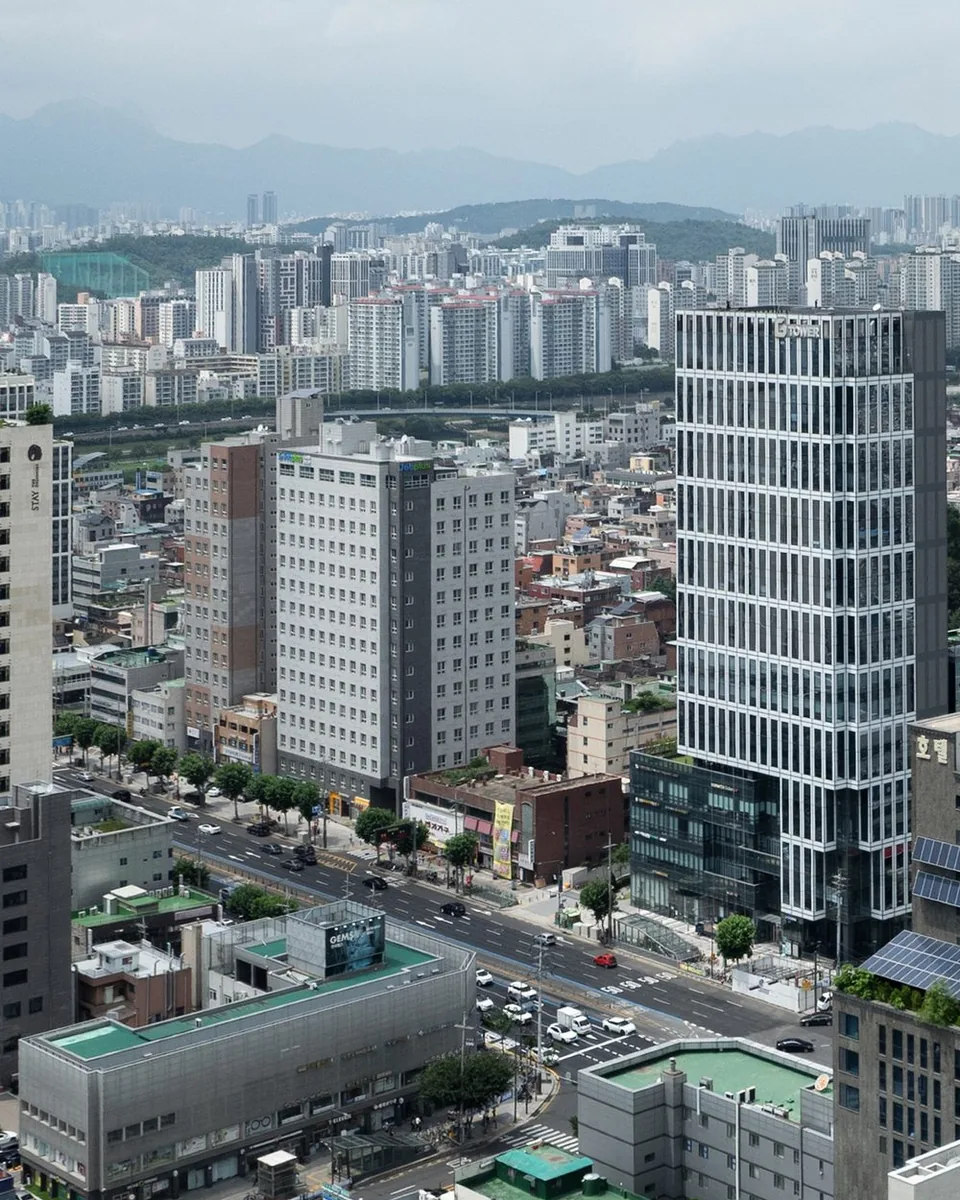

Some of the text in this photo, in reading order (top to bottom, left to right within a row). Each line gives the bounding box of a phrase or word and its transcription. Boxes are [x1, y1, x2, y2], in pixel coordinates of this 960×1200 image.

[787, 325, 820, 338] TOWER
[31, 490, 40, 511] STAY
[916, 735, 948, 765] 호텔
